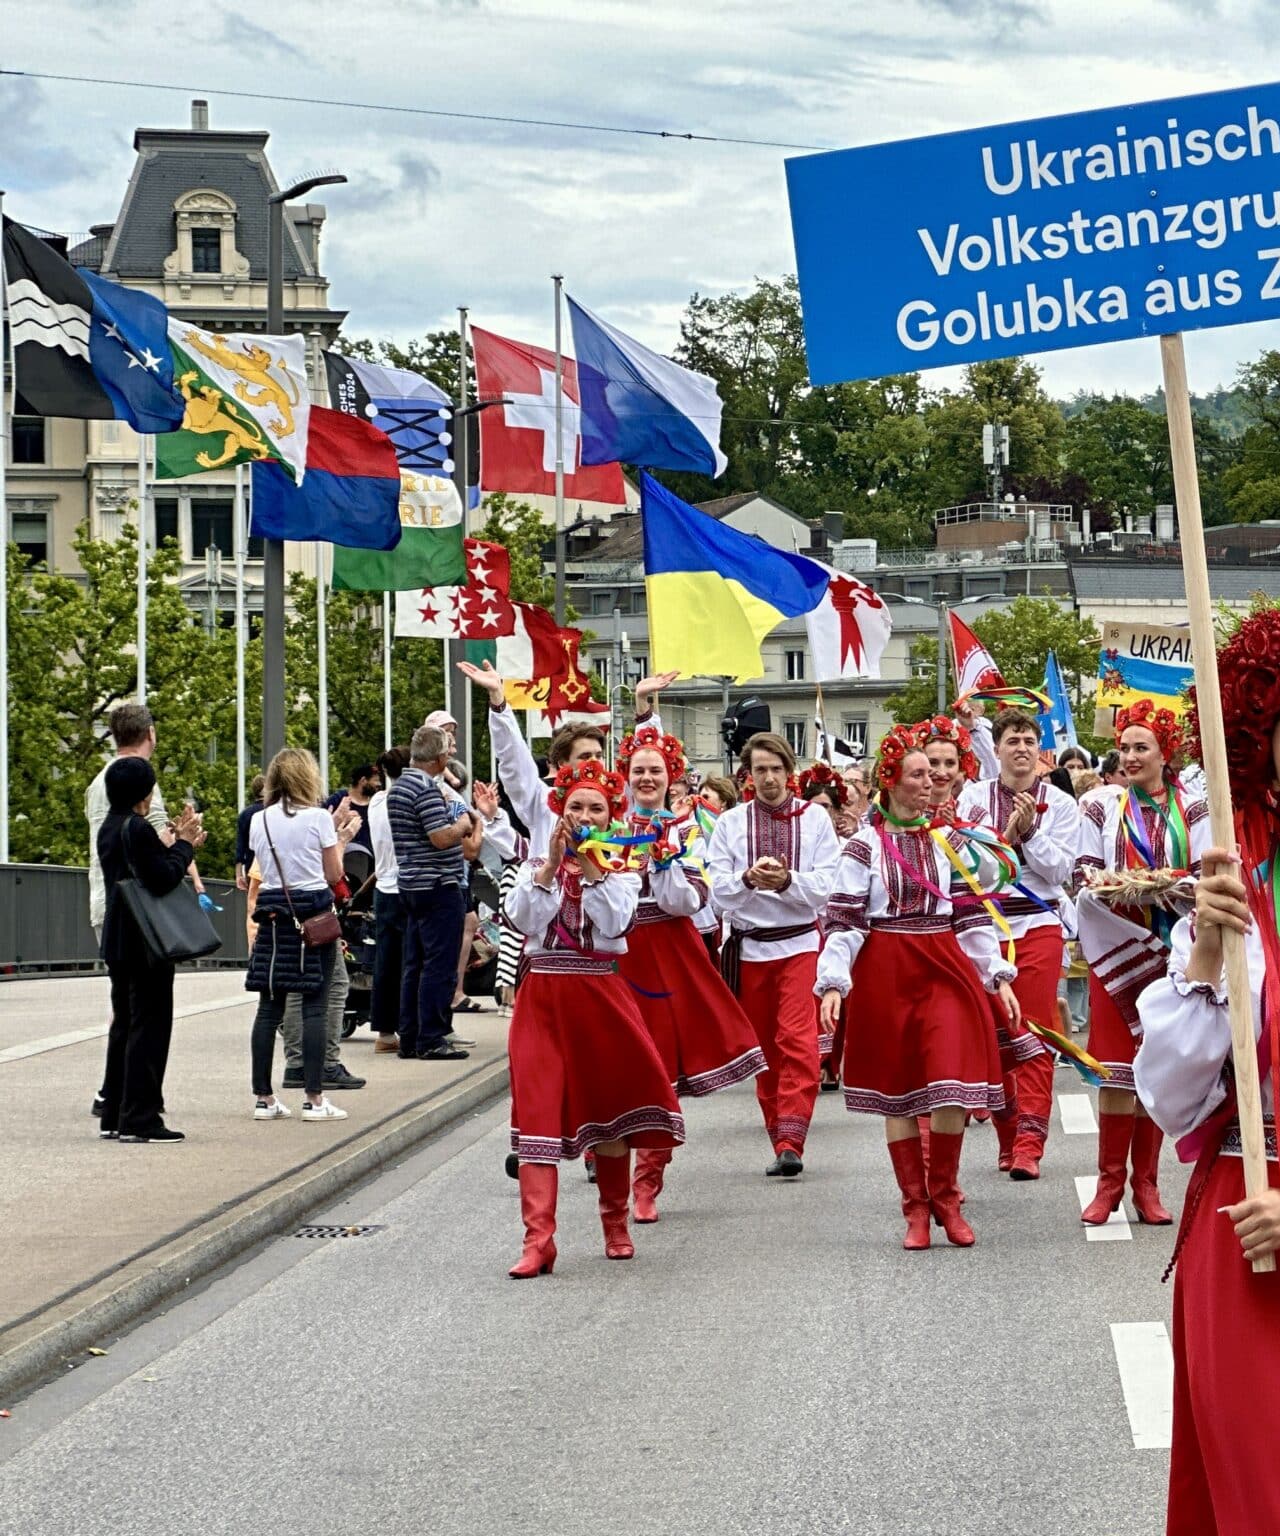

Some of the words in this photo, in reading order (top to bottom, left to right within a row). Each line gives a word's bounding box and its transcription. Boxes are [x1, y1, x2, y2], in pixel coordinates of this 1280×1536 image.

[896, 278, 1129, 351] Golubka
[1145, 269, 1242, 316] aus
[345, 373, 356, 399] 2024
[401, 505, 444, 526] RIE
[1110, 629, 1120, 639] 16
[1129, 633, 1192, 663] UKRAI
